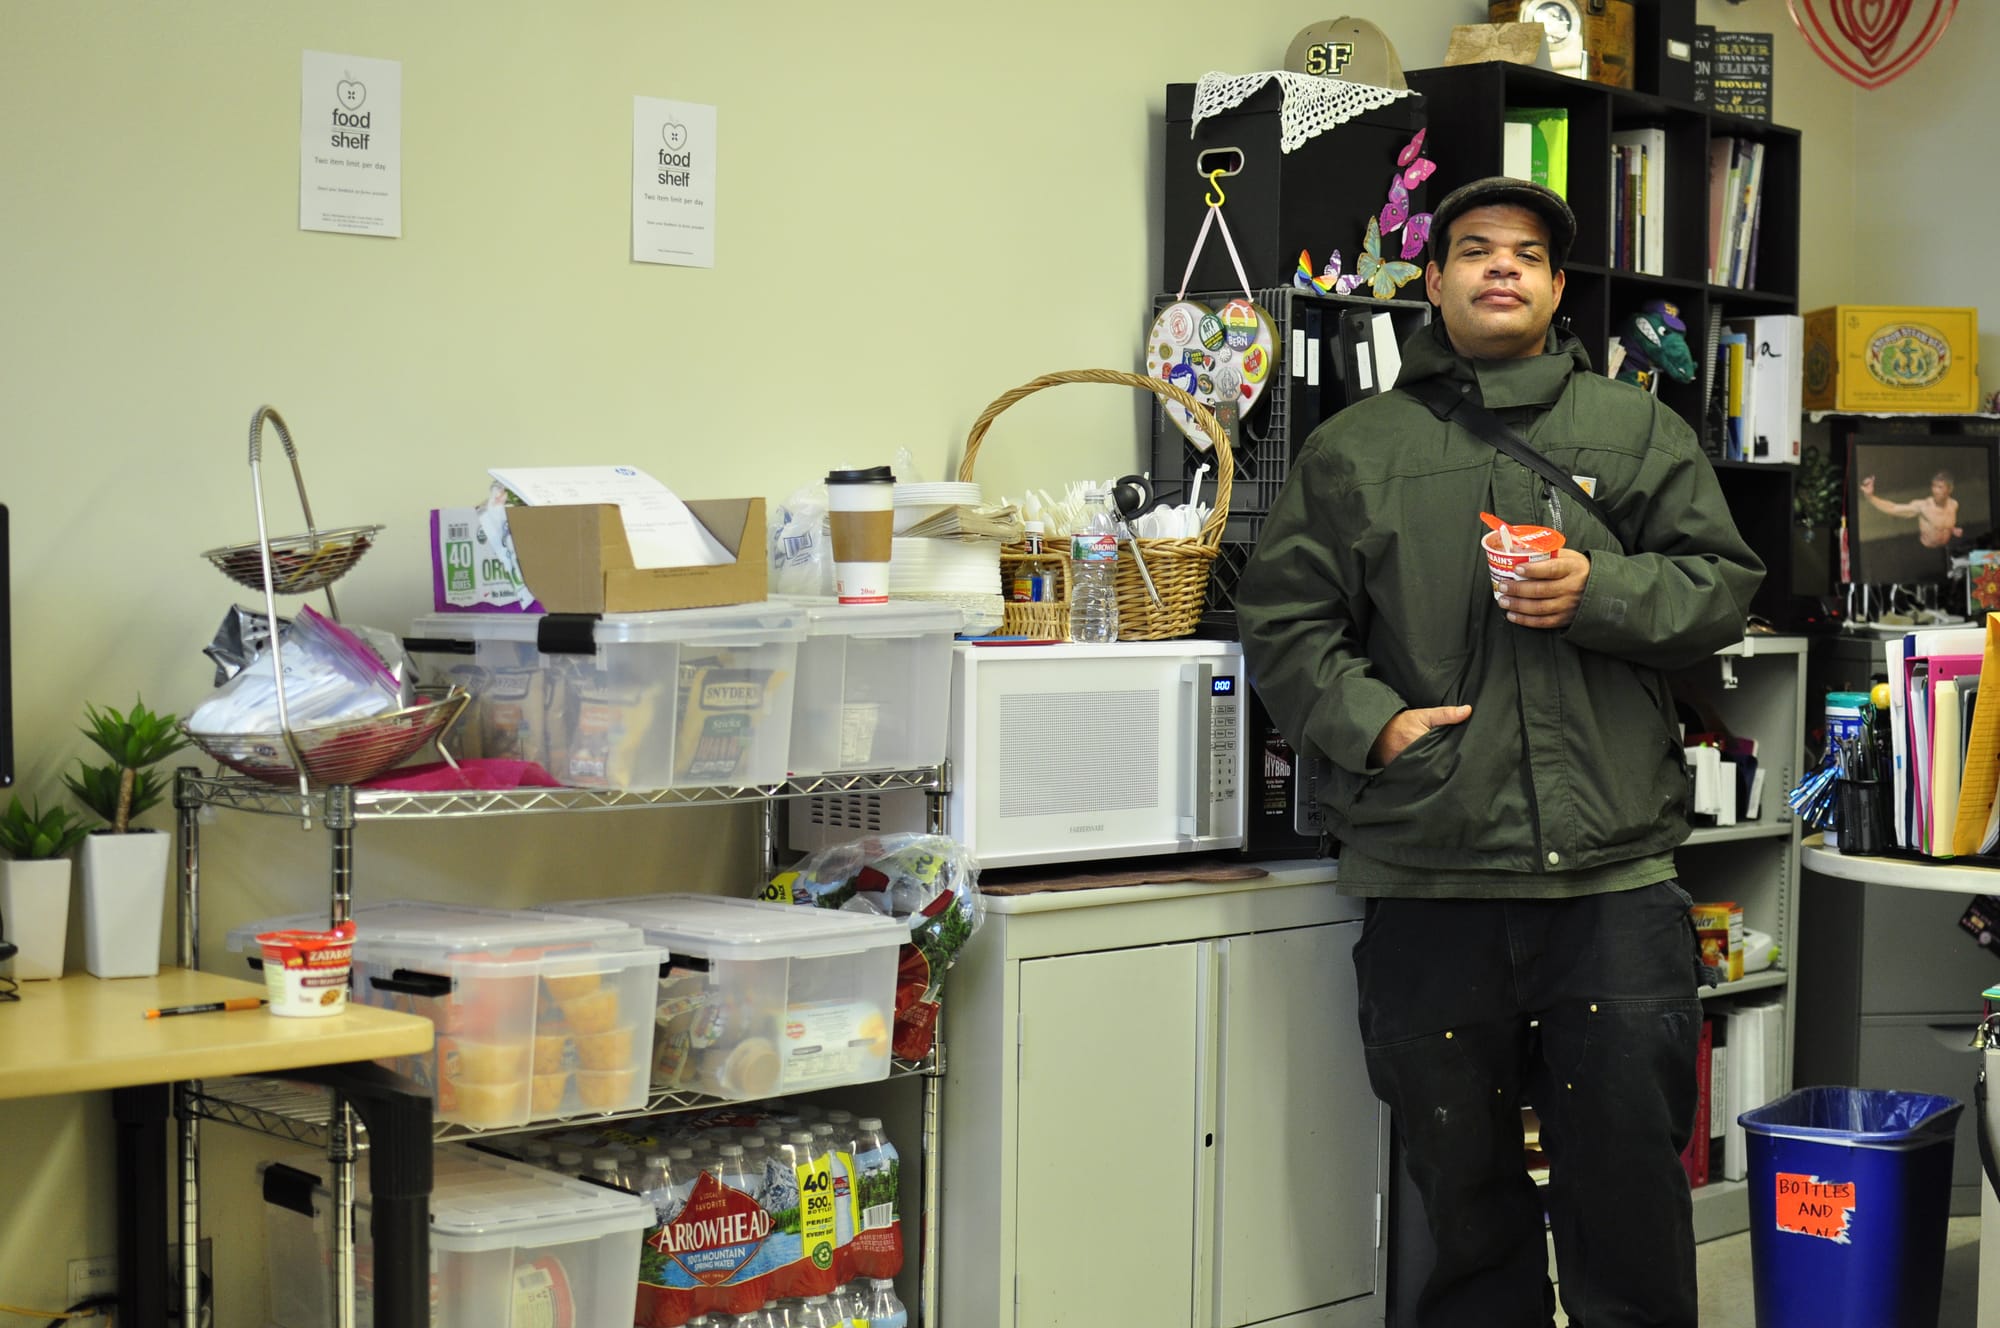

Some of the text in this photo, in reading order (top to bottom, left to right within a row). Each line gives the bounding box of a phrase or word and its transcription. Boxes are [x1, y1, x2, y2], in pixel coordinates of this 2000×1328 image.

[1305, 42, 1354, 75] SF
[331, 108, 371, 129] food
[331, 131, 371, 150] shelf
[314, 156, 329, 165] Two
[362, 162, 373, 170] per
[374, 162, 386, 172] day
[659, 149, 691, 168] food
[658, 170, 691, 187] shelf
[1228, 335, 1248, 348] BERN
[449, 542, 472, 569] 40
[803, 1171, 829, 1193] 40
[1780, 1179, 1850, 1198] BOTTLES
[696, 1199, 727, 1211] FAVORITE
[1798, 1201, 1833, 1217] AND
[657, 1209, 770, 1253] ARROWHEAD
[702, 1247, 746, 1262] MOUNTAIN
[714, 1259, 735, 1270] WATER
